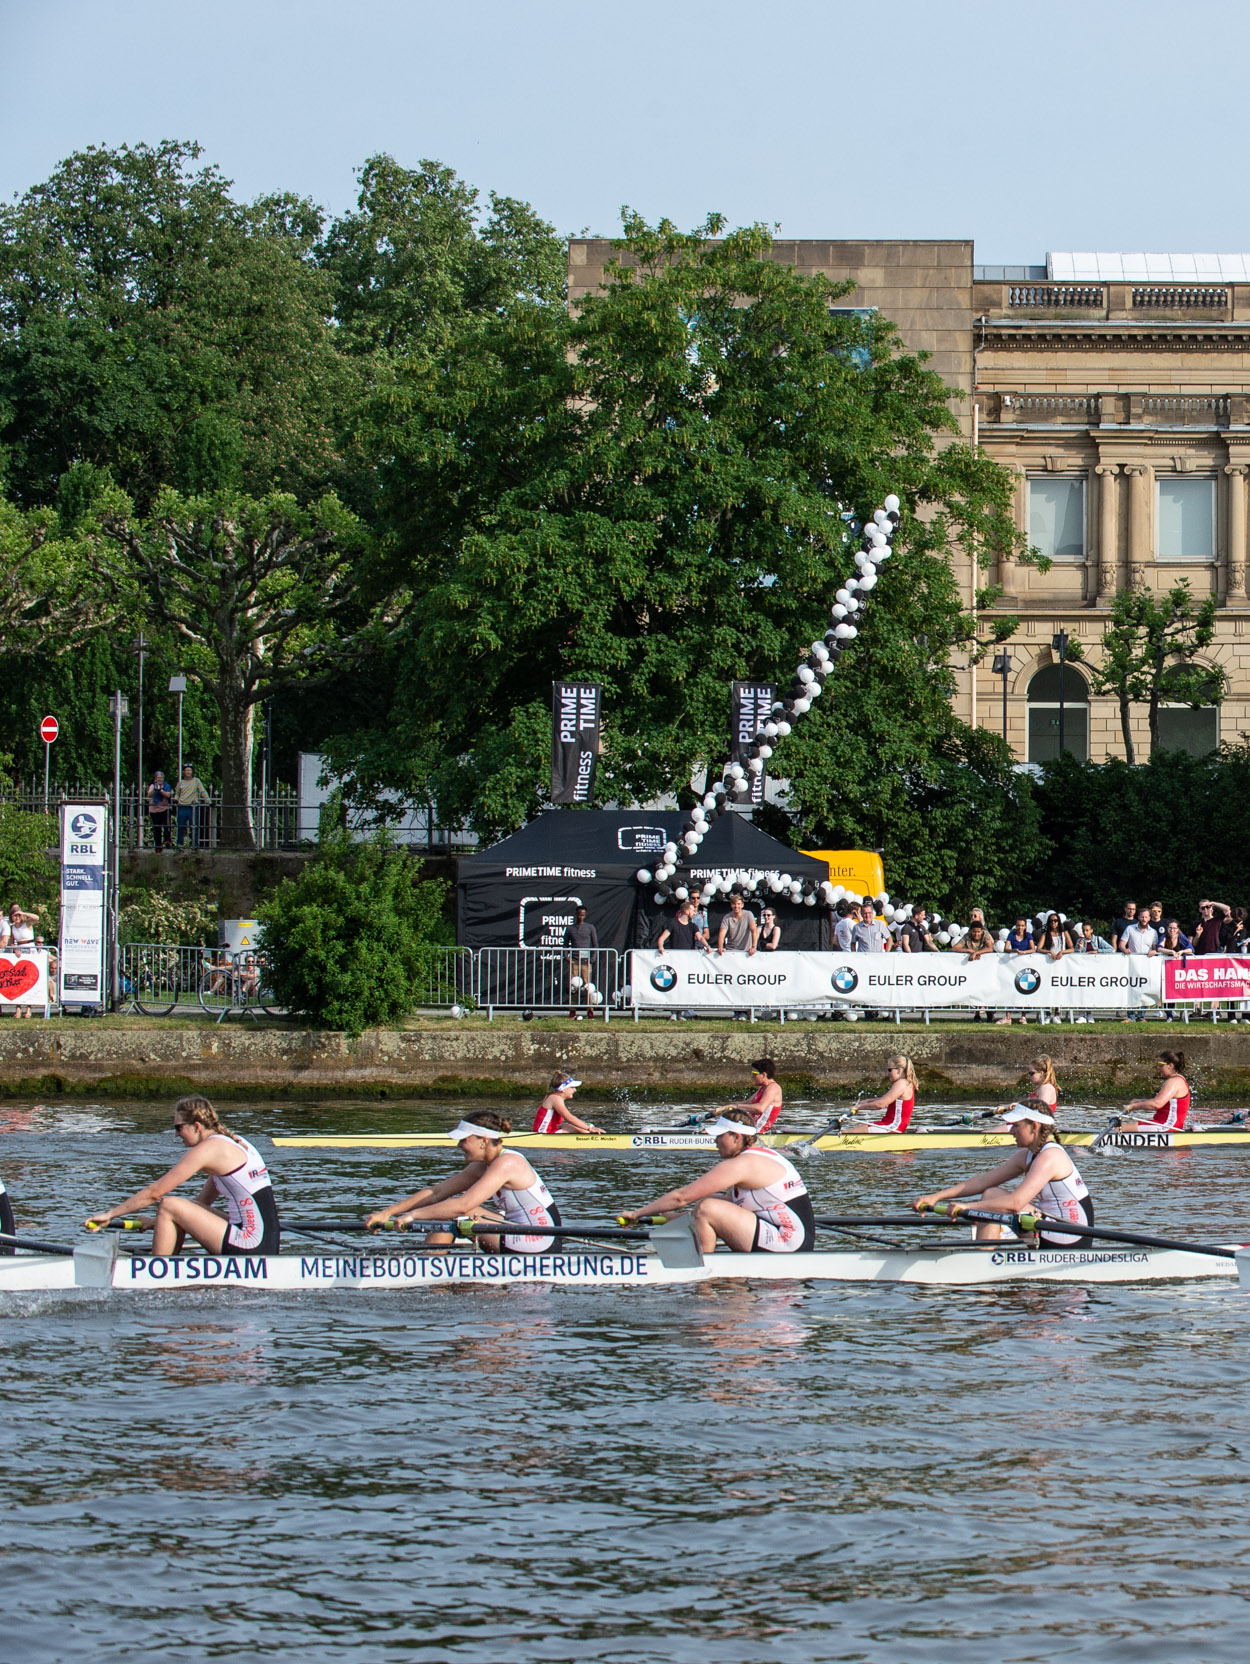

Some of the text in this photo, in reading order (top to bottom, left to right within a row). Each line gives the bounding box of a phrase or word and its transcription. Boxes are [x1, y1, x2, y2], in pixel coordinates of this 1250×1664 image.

[561, 687, 577, 743] PRIME
[579, 687, 596, 731] TIME
[739, 687, 755, 743] PRIME
[573, 751, 593, 801] fitness
[70, 844, 97, 854] RBL
[505, 866, 597, 878] PRIMETIME fitness
[690, 868, 746, 879] PRIMETIME
[829, 867, 857, 877] nter.
[542, 916, 574, 926] PRIME
[540, 935, 565, 946] fitne
[653, 964, 676, 976] BMW
[833, 966, 857, 977] BMW
[1016, 968, 1039, 978] BMW
[1175, 968, 1208, 981] DAS
[687, 974, 787, 986] EULER GROUP
[868, 975, 967, 986] EULER GROUP
[1051, 976, 1148, 988] EULER GROUP
[1174, 982, 1186, 990] DIE
[644, 1136, 716, 1145] RBL RUDER-BUND
[1099, 1134, 1169, 1147] MINDEN
[1006, 1252, 1148, 1264] RBL RUDER-BUNDESLIGA
[130, 1256, 648, 1279] POTSDAM MEINEBOOTSVERSICHERUNG.DE
